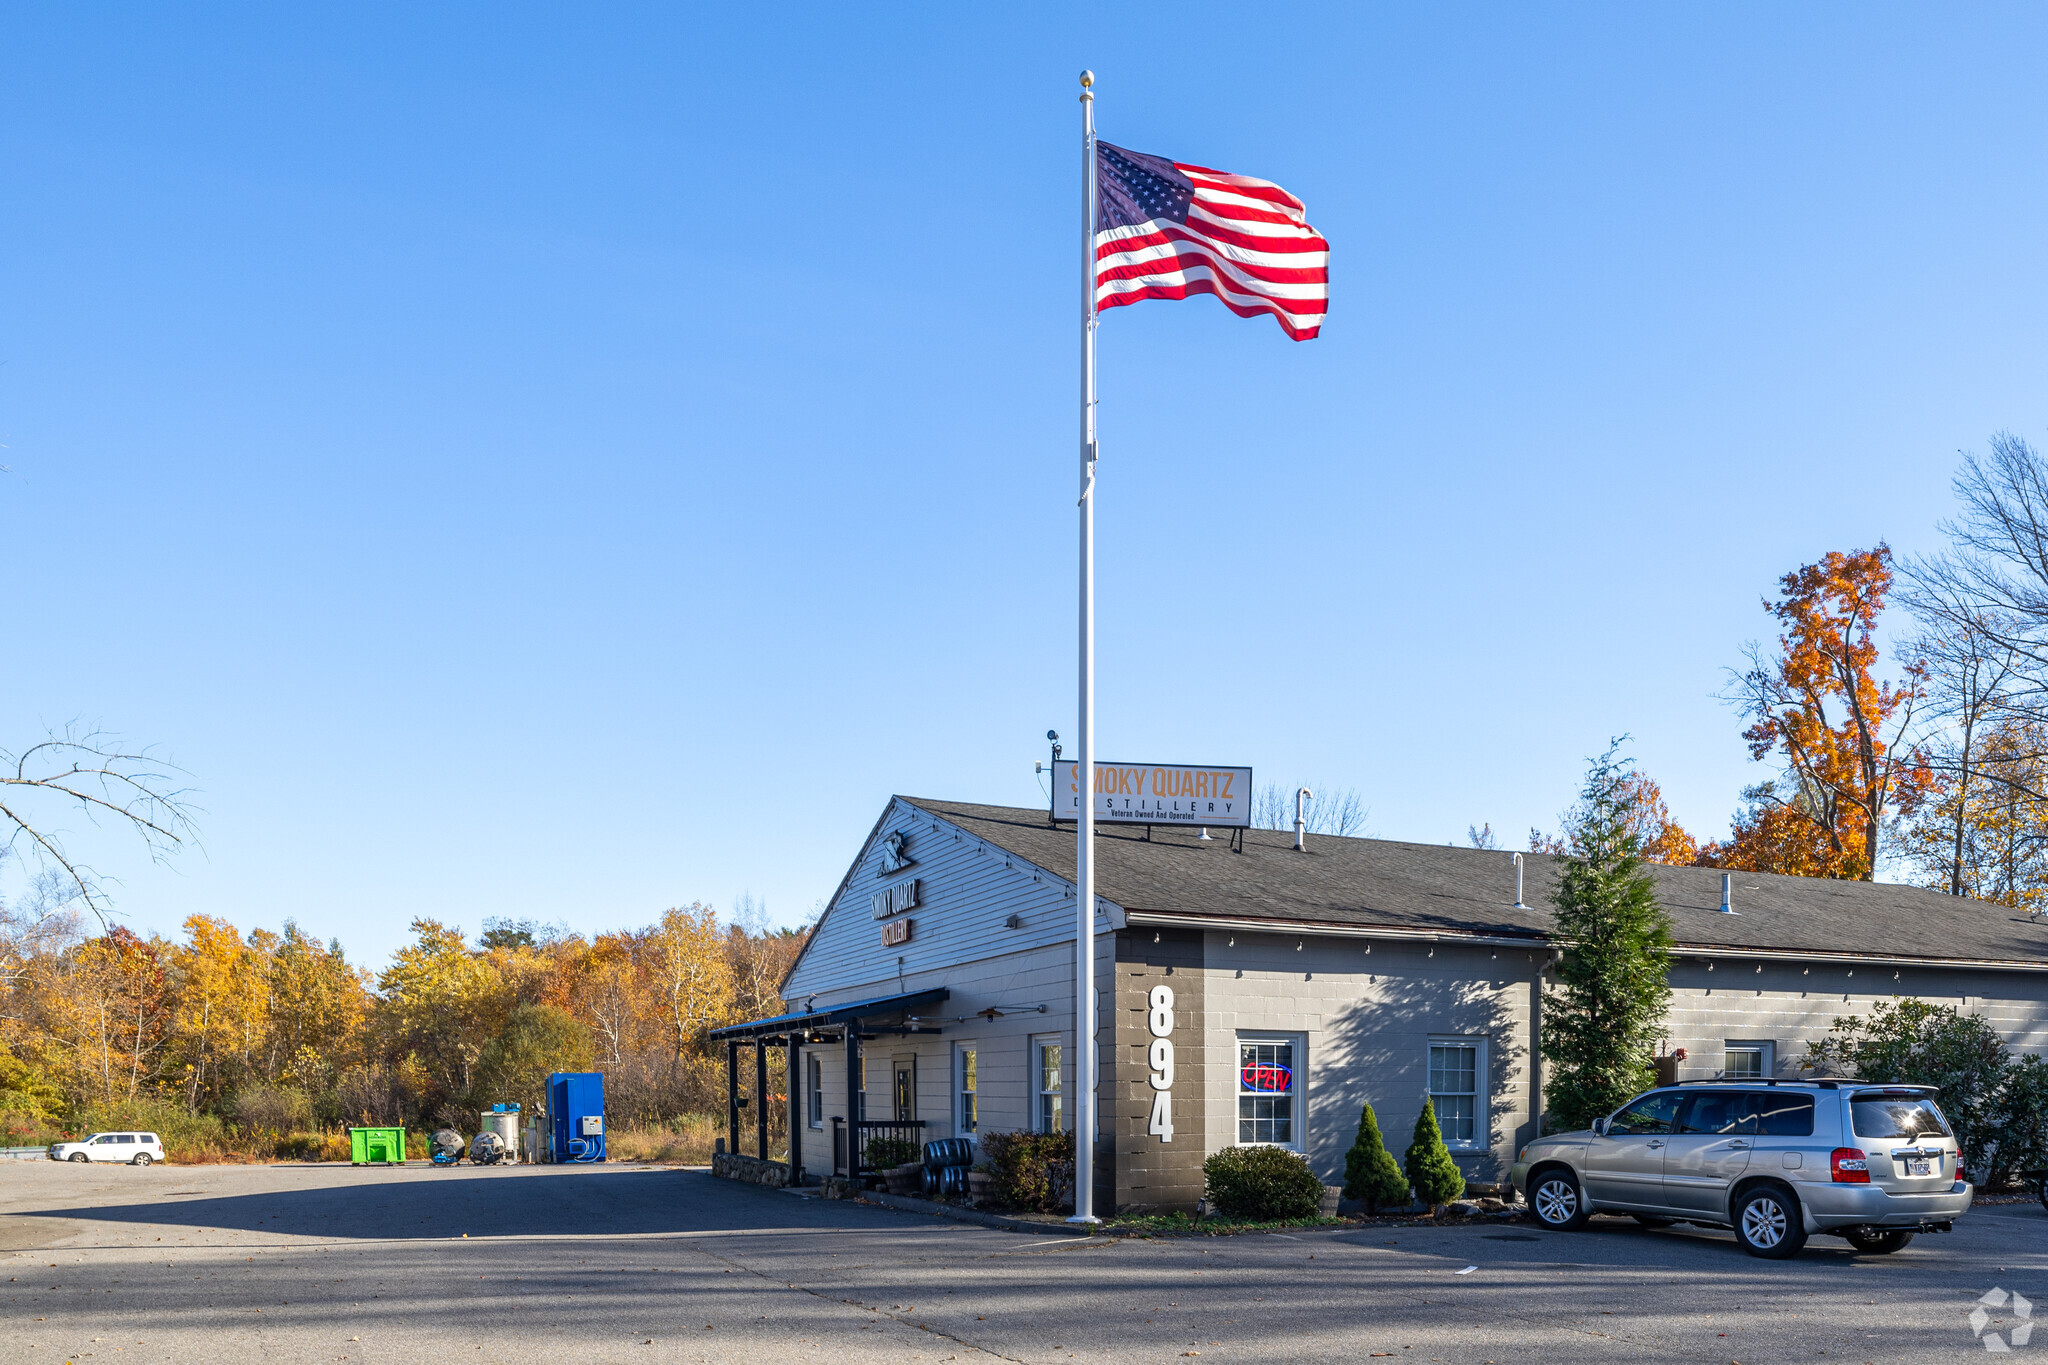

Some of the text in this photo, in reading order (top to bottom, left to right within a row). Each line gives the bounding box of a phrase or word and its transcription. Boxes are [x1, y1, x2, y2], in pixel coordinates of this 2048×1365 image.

[1152, 767, 1234, 799] QUARTZ
[1111, 809, 1195, 820] Veteran Owned And Operated
[871, 879, 916, 920] SMOKY QUARTZ
[1149, 984, 1174, 1143] 894
[1243, 1062, 1290, 1091] OPEN
